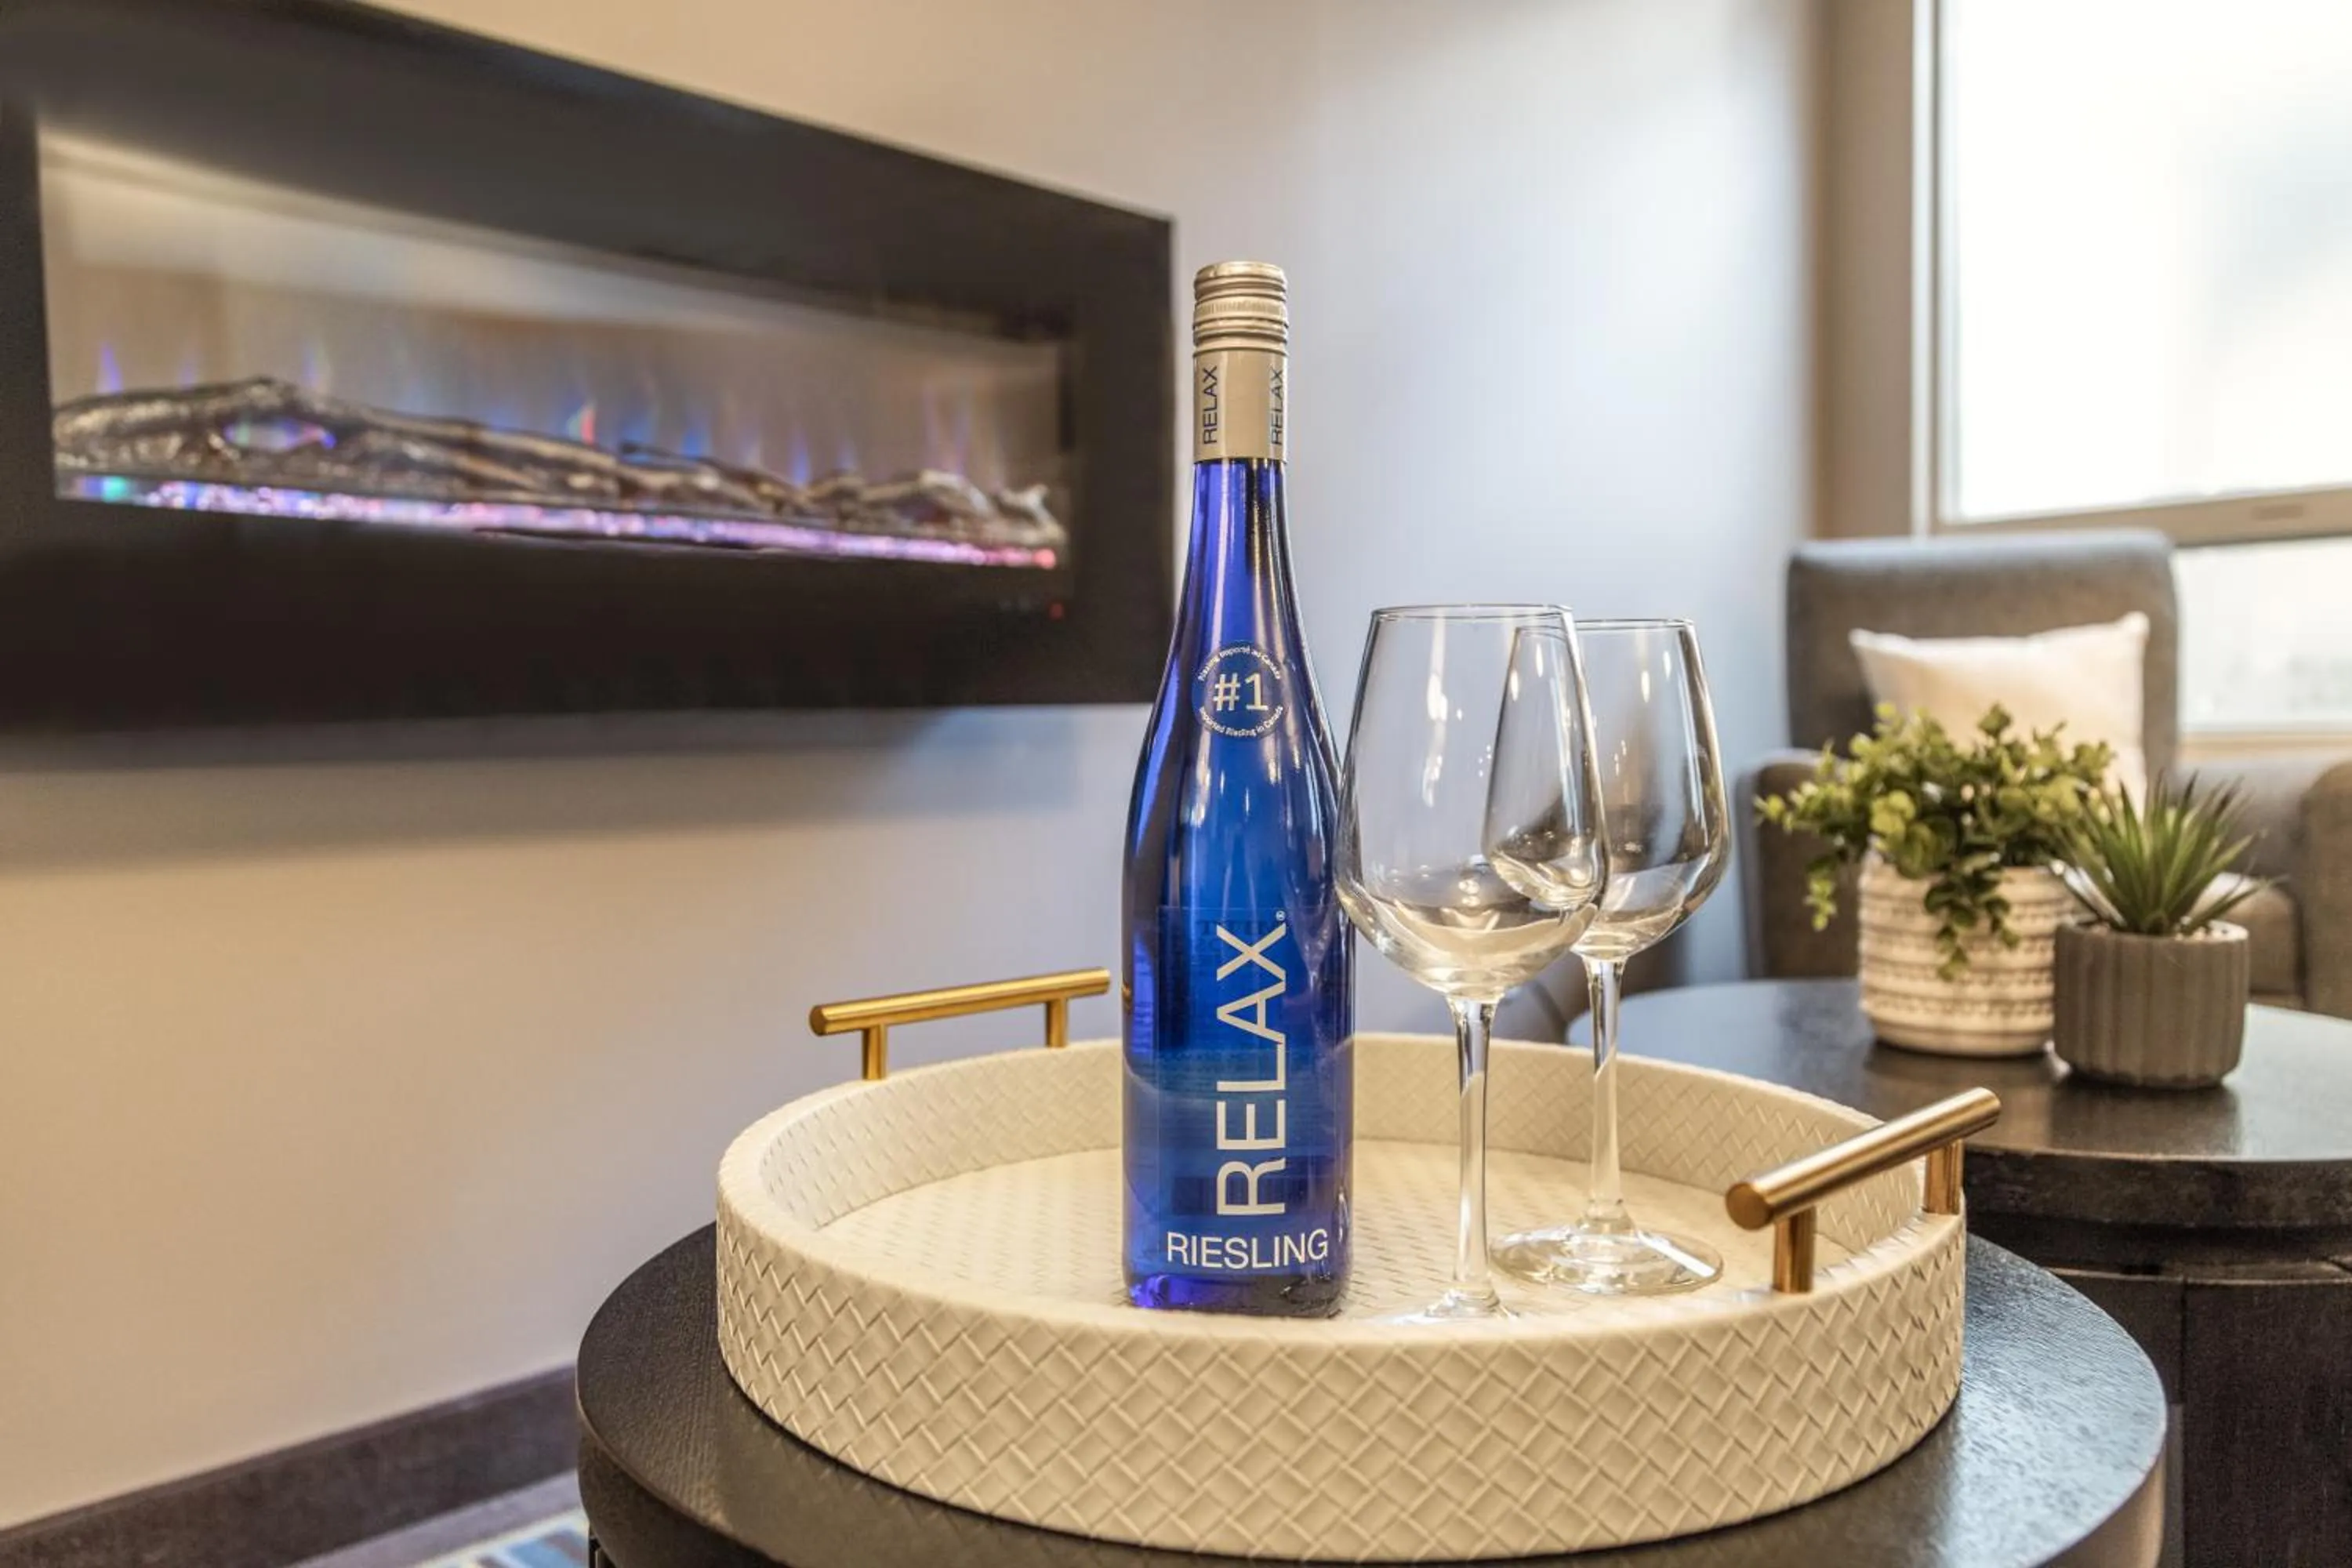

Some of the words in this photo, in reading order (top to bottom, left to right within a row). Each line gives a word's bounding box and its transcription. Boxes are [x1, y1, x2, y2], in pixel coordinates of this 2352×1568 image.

[1203, 365, 1218, 445] RELAX
[1271, 368, 1283, 445] RELAX
[1213, 673, 1269, 711] #1
[1263, 706, 1283, 728] Canada
[1167, 1229, 1328, 1269] RIESLING
